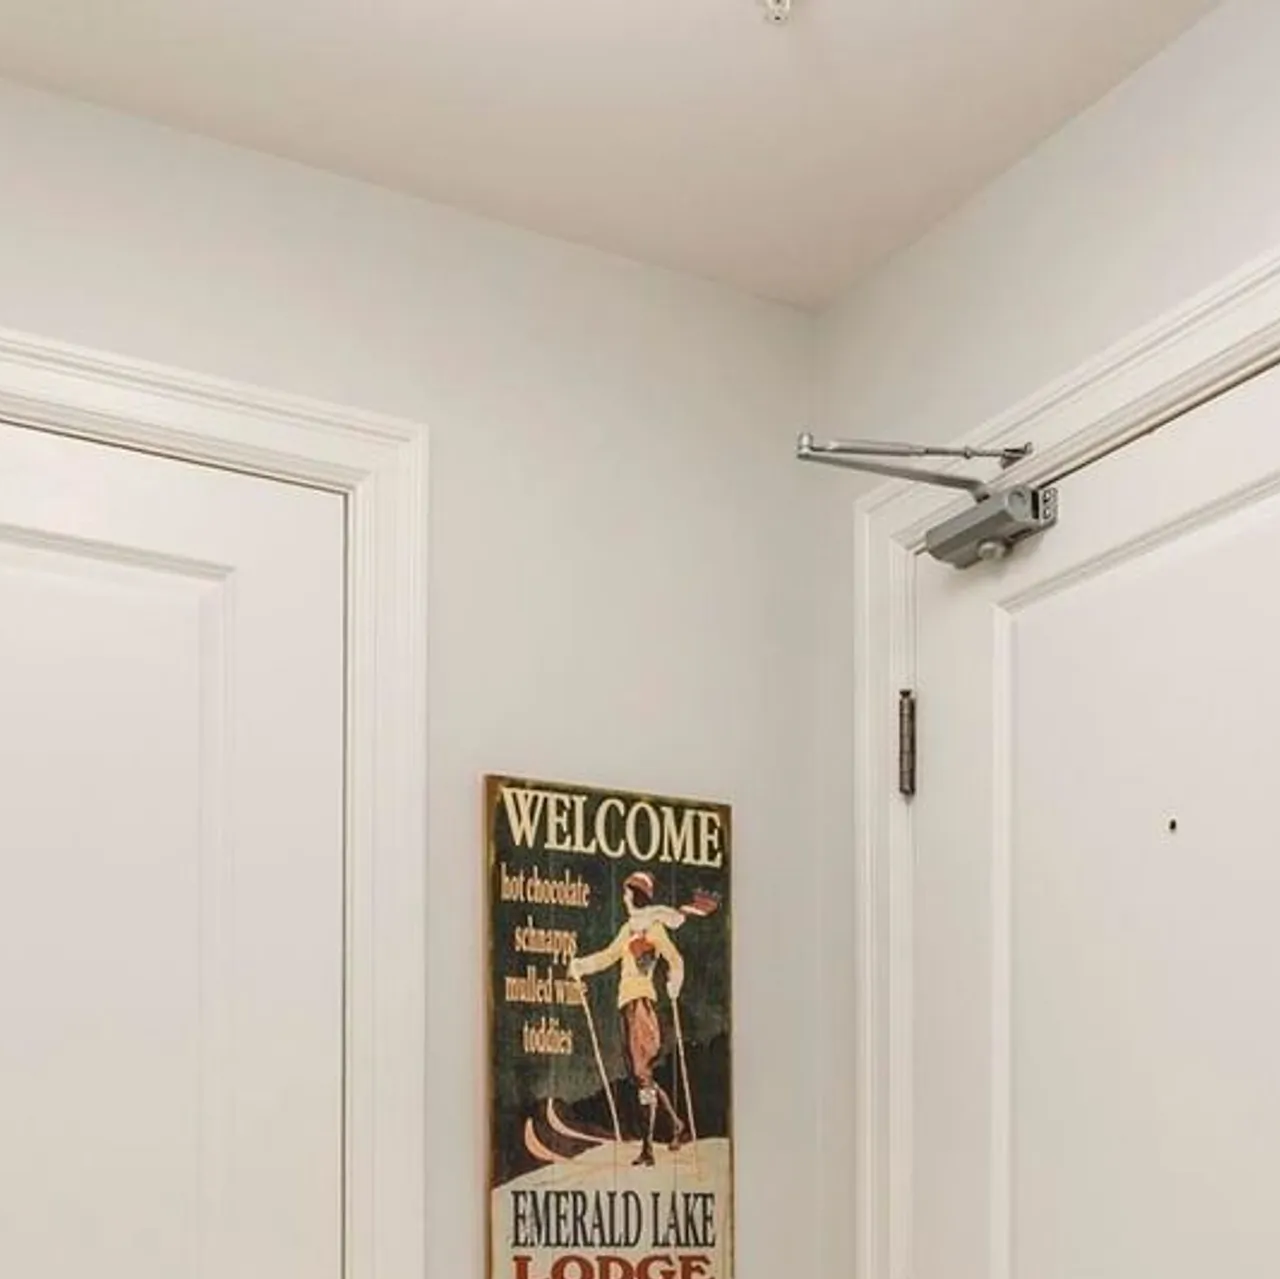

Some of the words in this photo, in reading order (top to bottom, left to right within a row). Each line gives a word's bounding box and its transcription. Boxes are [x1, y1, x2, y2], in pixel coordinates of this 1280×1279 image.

[500, 786, 721, 867] WELCOME
[500, 862, 525, 901] hot
[527, 865, 590, 908] chocolate
[515, 915, 578, 966] schnapps
[505, 965, 553, 1002] mulled
[523, 1016, 572, 1054] toddies
[511, 1190, 642, 1249] EMERALD
[651, 1191, 716, 1248] LAKE
